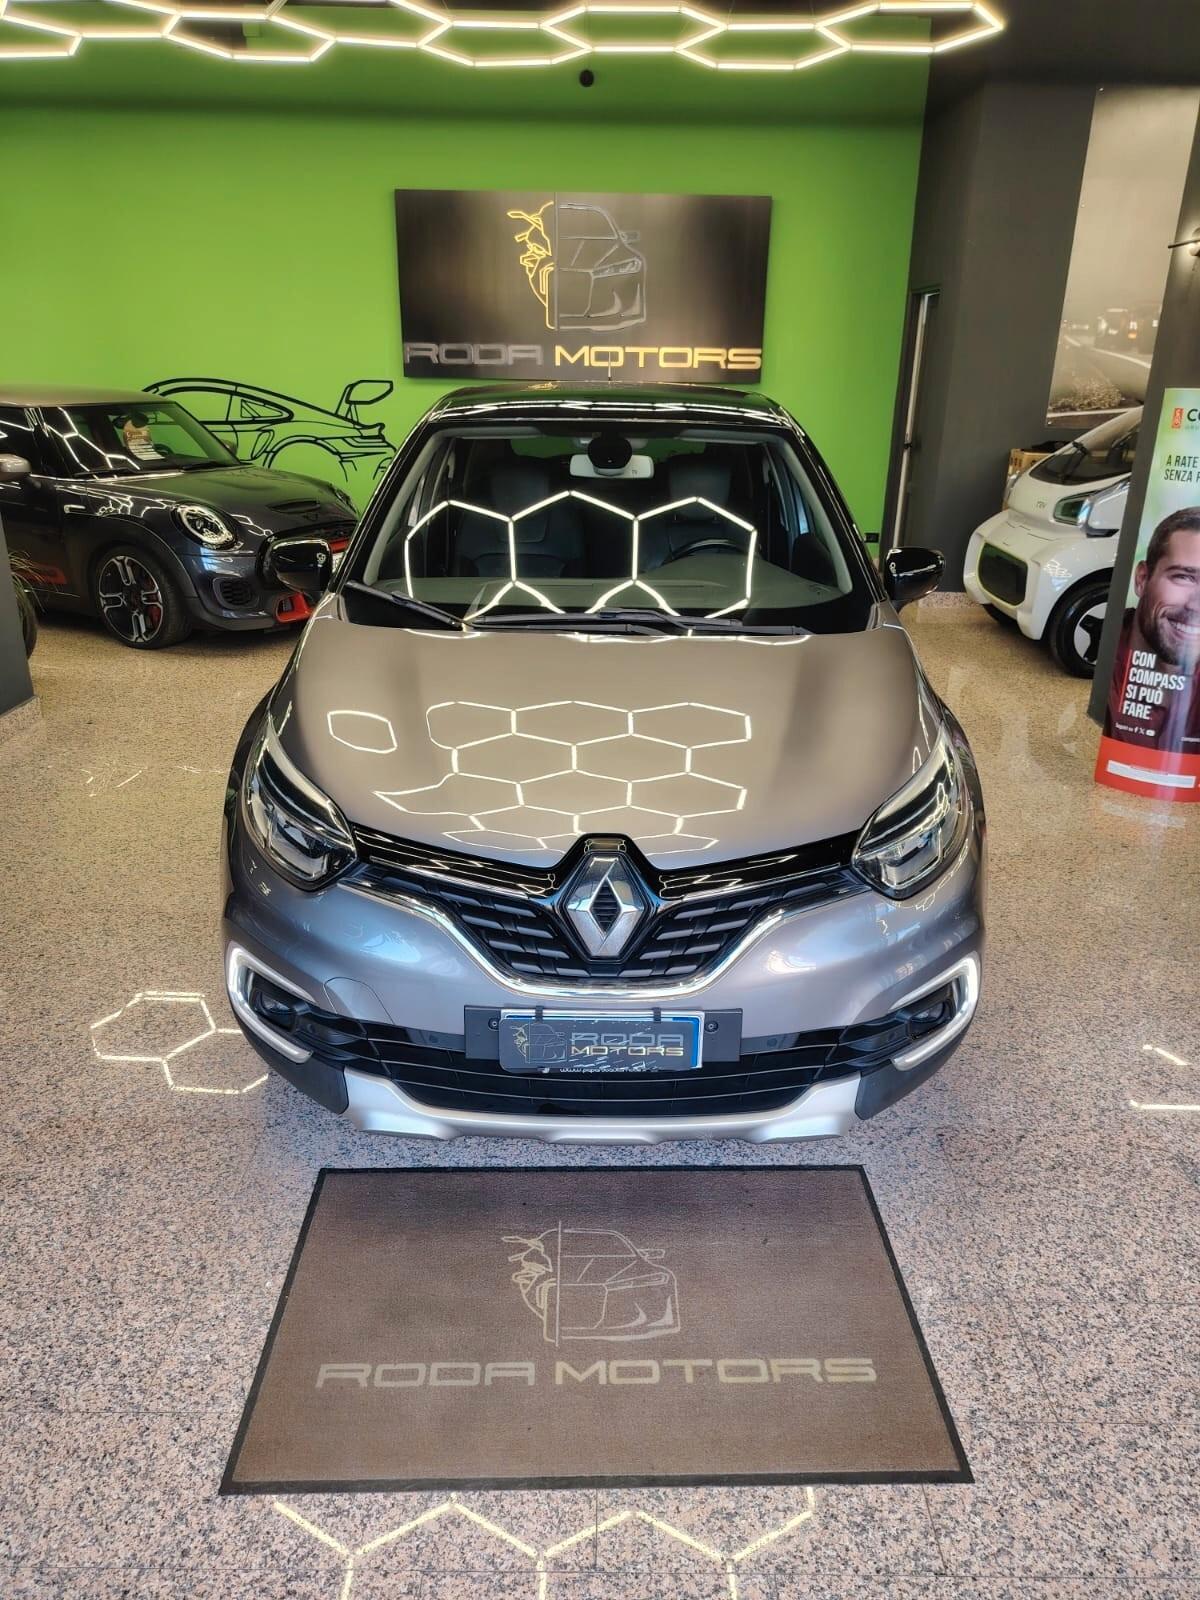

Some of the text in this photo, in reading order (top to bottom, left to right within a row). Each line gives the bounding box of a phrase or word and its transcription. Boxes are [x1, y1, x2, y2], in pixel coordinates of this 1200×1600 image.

[403, 343, 762, 369] RODA MOTORS
[1166, 454, 1200, 468] A RATE
[1164, 468, 1193, 481] SENZA
[1132, 650, 1157, 668] CON
[1129, 667, 1186, 690] COMPASS
[1125, 684, 1163, 705] SI PUÒ
[571, 1032, 684, 1047] RODA
[571, 1046, 684, 1057] MOTORS
[315, 1358, 877, 1388] RODA MOTORS
